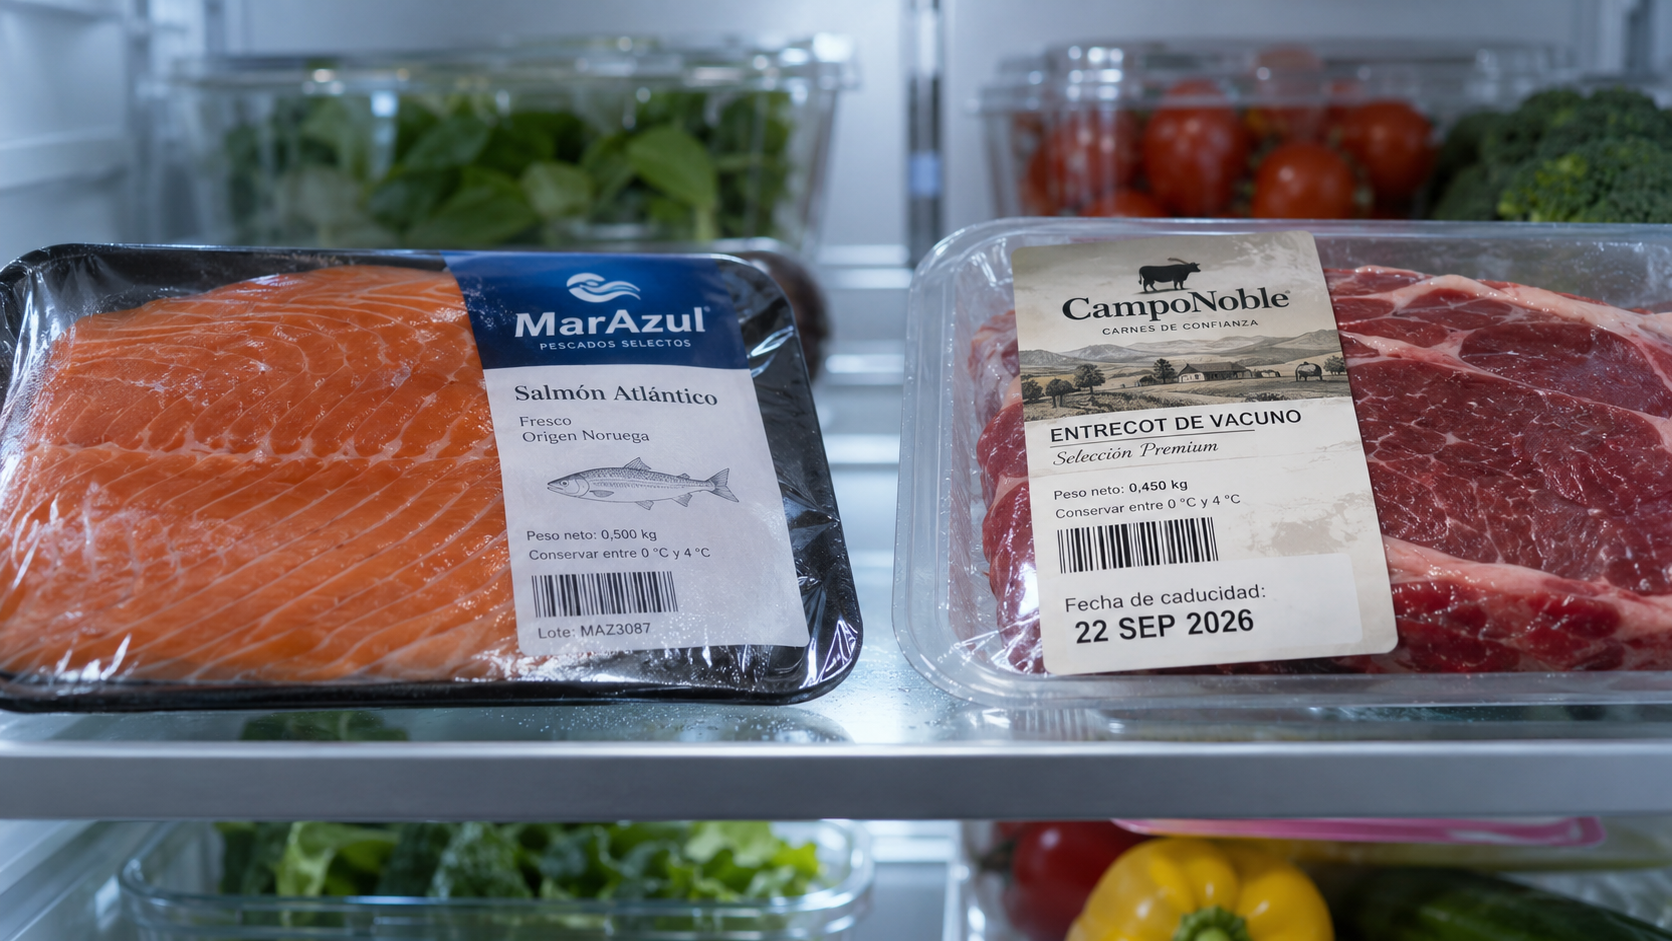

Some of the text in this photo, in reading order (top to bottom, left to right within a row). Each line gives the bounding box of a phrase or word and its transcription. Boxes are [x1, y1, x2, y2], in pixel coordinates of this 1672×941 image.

[1062, 287, 1291, 322] CampoNoble
[514, 306, 706, 338] MarAzul
[1102, 319, 1259, 336] CARNES DE CONFIANZA
[539, 338, 692, 351] PESCADOS SELECTOS
[514, 384, 718, 406] Salmón Atlántico
[519, 415, 572, 427] Fresco
[1050, 409, 1302, 443] ENTRECOT DE VACUNO
[522, 429, 650, 444] Origen Noruega
[1052, 440, 1218, 466] Selección Premium
[1054, 479, 1188, 500] Peso neto: 0,450 kg
[1055, 505, 1125, 519] Conservar
[1129, 500, 1164, 512] entre
[1167, 498, 1176, 509] 0
[1200, 498, 1208, 509] y
[1212, 495, 1221, 506] 4
[526, 528, 657, 542] Peso neto: 0,500 kg
[529, 549, 598, 561] Conservar
[603, 548, 637, 559] entre
[641, 548, 650, 558] 0
[672, 550, 680, 560] y
[683, 547, 692, 558] 4
[1065, 583, 1266, 613] Fecha de caducidad:
[538, 622, 651, 639] Lote: MAZ3087
[1074, 608, 1254, 644] 22 SEP 2026
